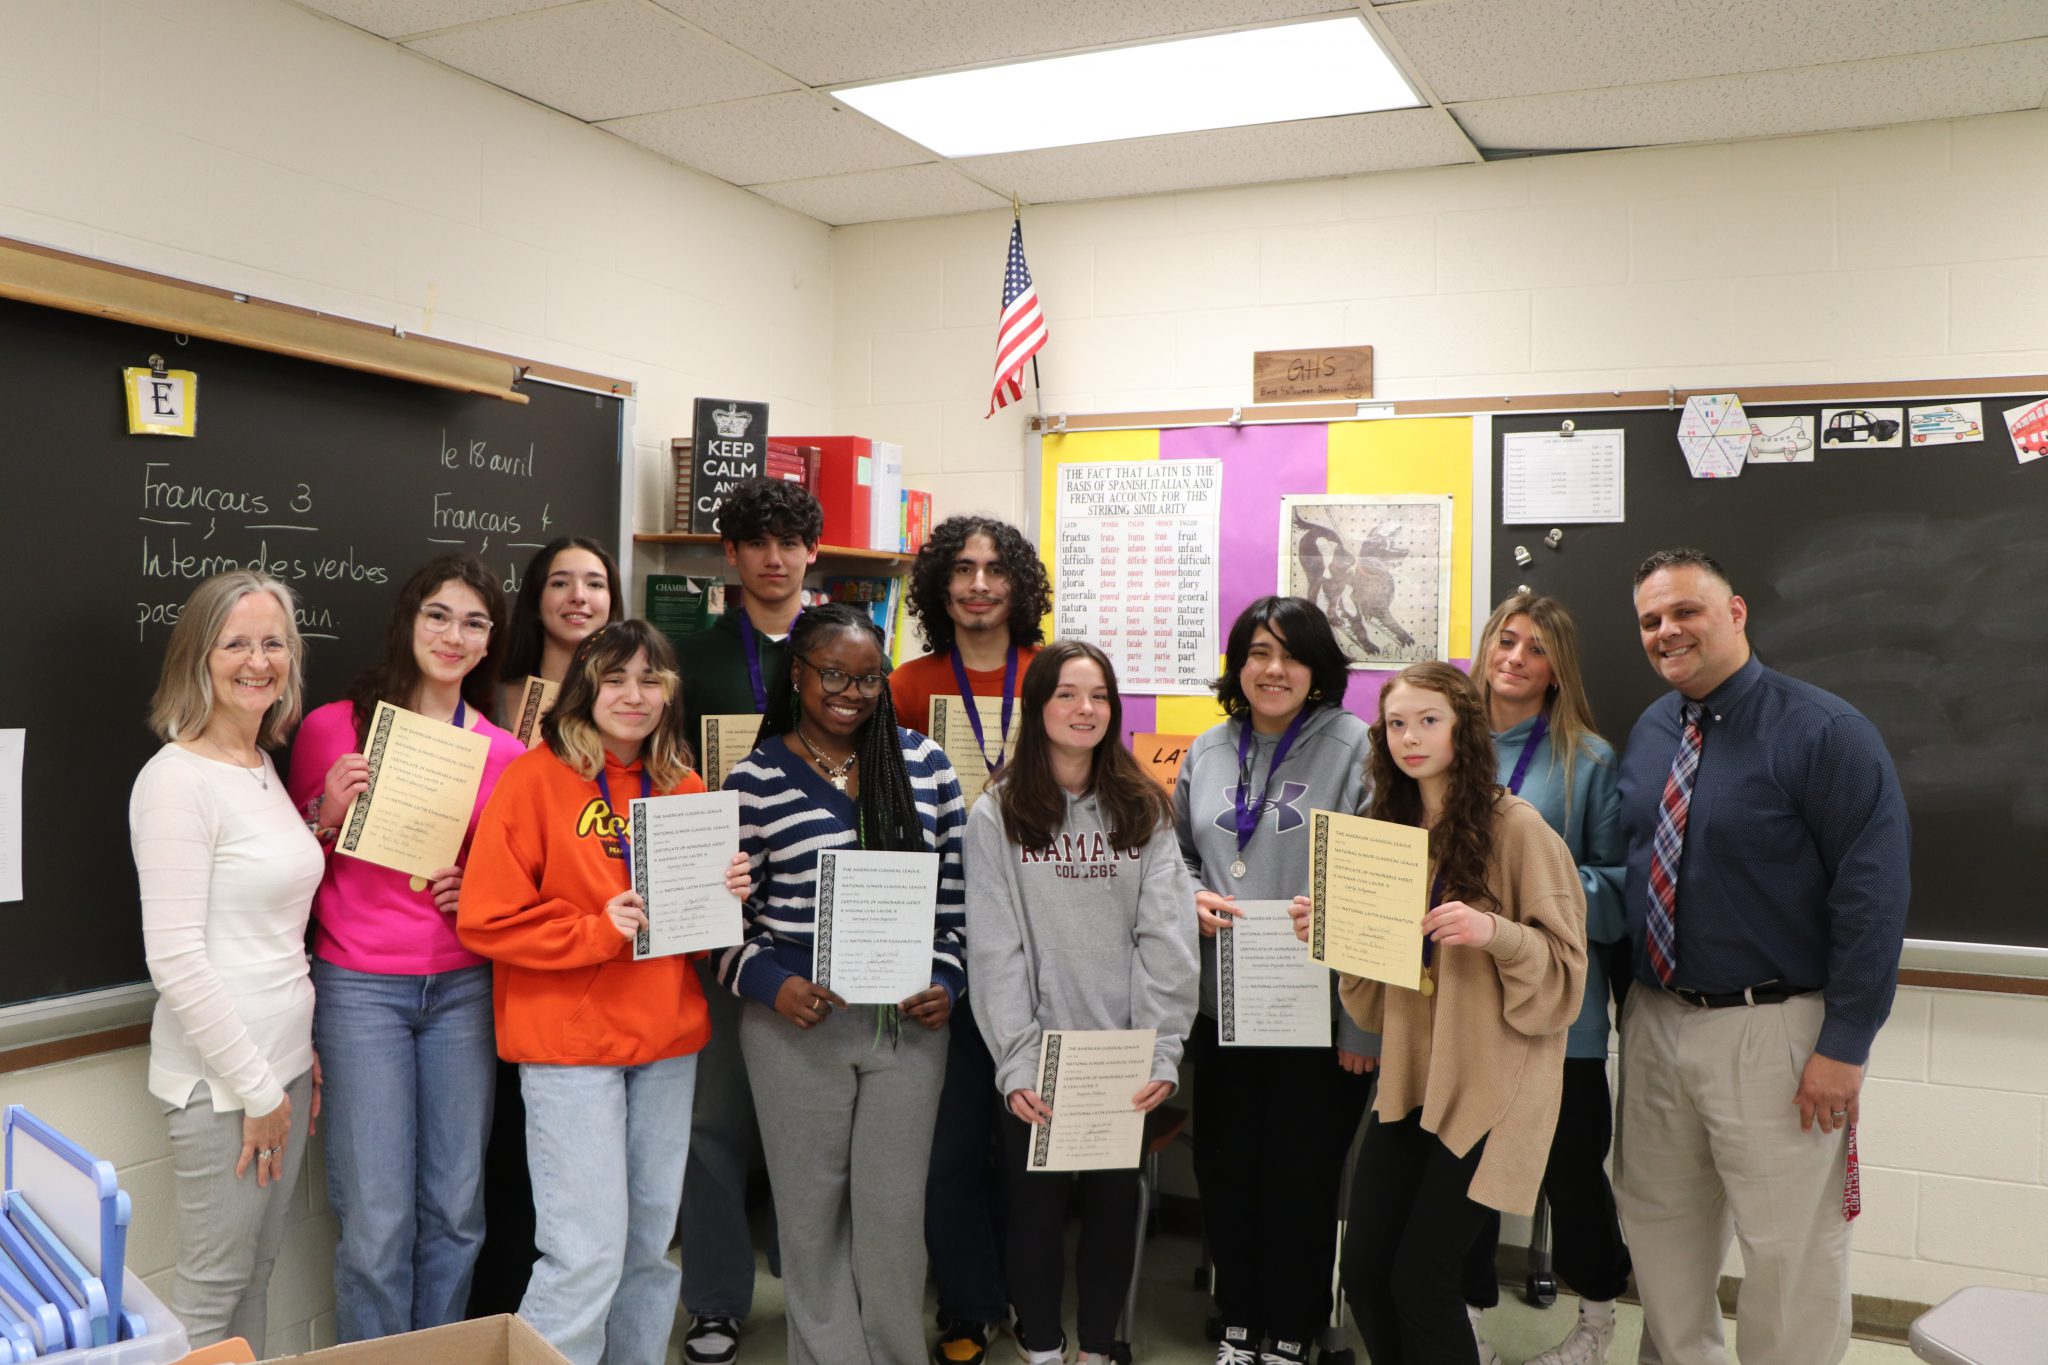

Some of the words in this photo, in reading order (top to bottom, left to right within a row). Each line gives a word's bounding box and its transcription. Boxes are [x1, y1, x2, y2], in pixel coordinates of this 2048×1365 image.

[1287, 353, 1336, 381] GHS
[151, 382, 177, 418] E
[708, 440, 754, 458] KEEP
[490, 442, 535, 477] avril
[703, 460, 757, 478] CALM
[1066, 468, 1084, 480] THE
[1087, 468, 1112, 478] FACT
[1116, 467, 1143, 478] THAT
[1147, 466, 1178, 478] LATIN
[1182, 466, 1192, 477] IS
[1195, 466, 1214, 476] THE
[714, 481, 736, 493] AN
[1067, 480, 1092, 492] BASIS
[1094, 480, 1105, 490] OF
[1193, 478, 1213, 488] AND
[290, 484, 312, 512] 3
[1070, 493, 1104, 504] FRENCH
[1110, 491, 1158, 503] ACCOUNTS
[1162, 491, 1180, 502] FOR
[1186, 490, 1208, 502] THIS
[1088, 504, 1130, 516] STRIKING
[1134, 504, 1188, 515] SIMILARITY
[1062, 532, 1090, 542] fructus
[1178, 530, 1197, 541] fruit
[1062, 543, 1086, 554] infans
[1178, 543, 1202, 552] infant
[1062, 554, 1094, 564] difficilis
[1178, 554, 1210, 564] difficult
[313, 546, 389, 584] verbes
[1062, 566, 1085, 576] honor
[1178, 566, 1202, 576] honor
[656, 583, 688, 592] CHAMBE
[1062, 578, 1085, 590] gloria
[1178, 578, 1200, 590] glory
[1062, 590, 1096, 601] generalis
[1178, 590, 1208, 602] general
[1062, 603, 1087, 612] natura
[1178, 605, 1204, 614] nature
[1062, 613, 1075, 624] flos
[1178, 614, 1204, 626] flower
[1062, 624, 1087, 635] animal
[1178, 627, 1205, 638] animal
[1178, 638, 1198, 650] fatal
[1178, 652, 1196, 662] part
[1178, 666, 1196, 674] rose
[1178, 677, 1208, 686] sermon
